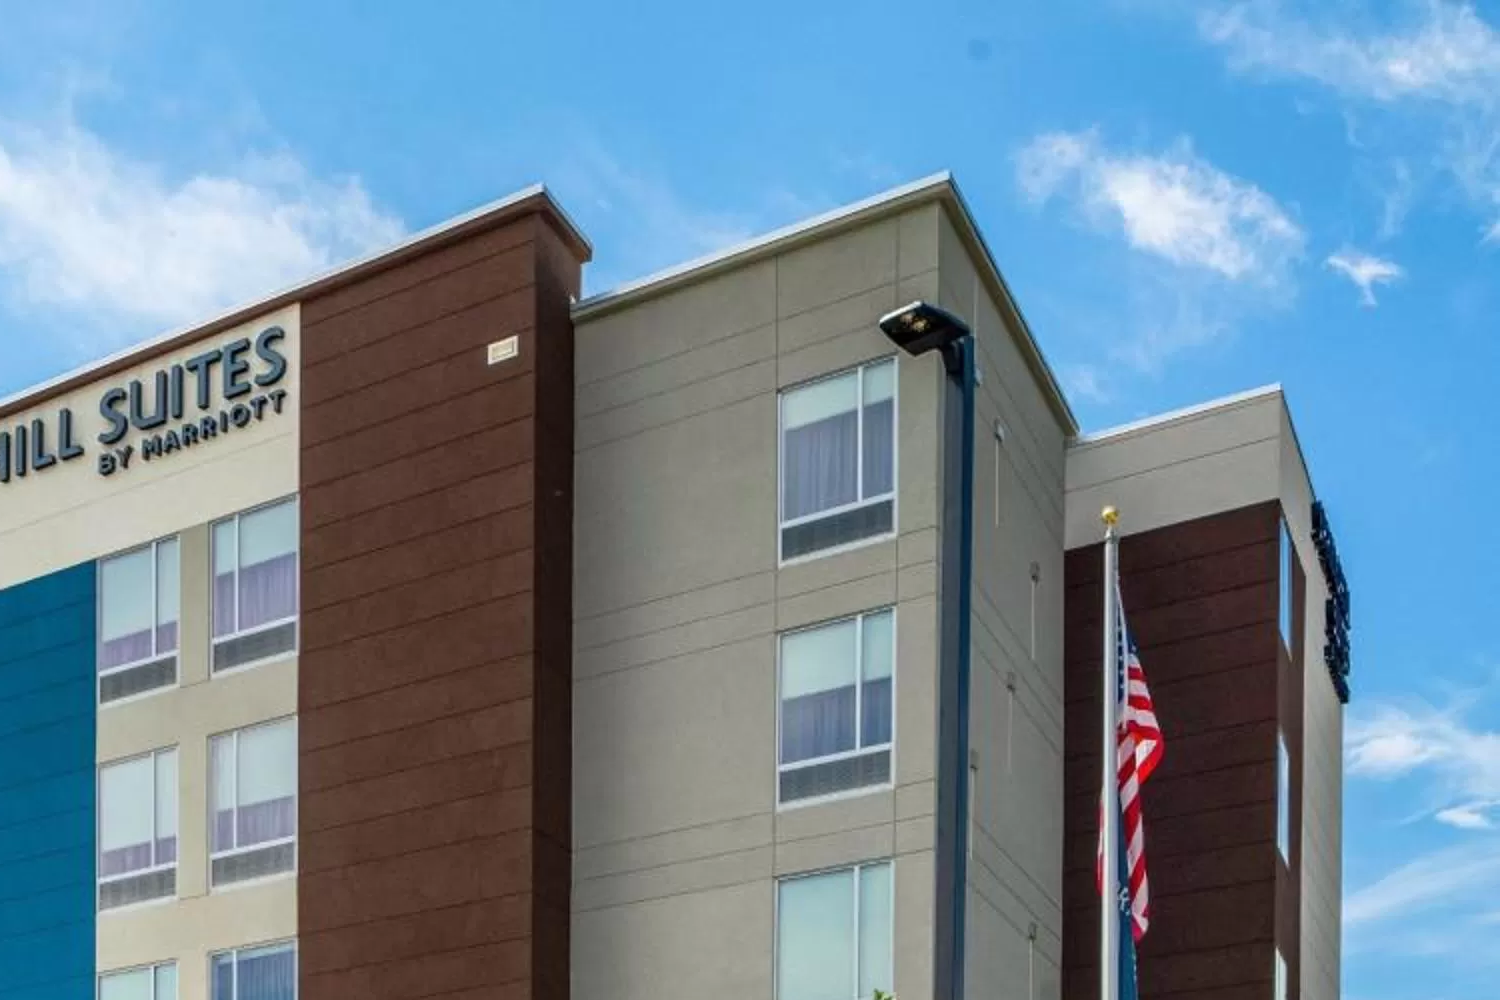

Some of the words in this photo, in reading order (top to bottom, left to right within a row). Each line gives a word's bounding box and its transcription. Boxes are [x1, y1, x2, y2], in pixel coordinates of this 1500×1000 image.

[98, 325, 287, 444] SUITES
[98, 445, 134, 476] BY
[142, 388, 287, 461] MARRIOTT
